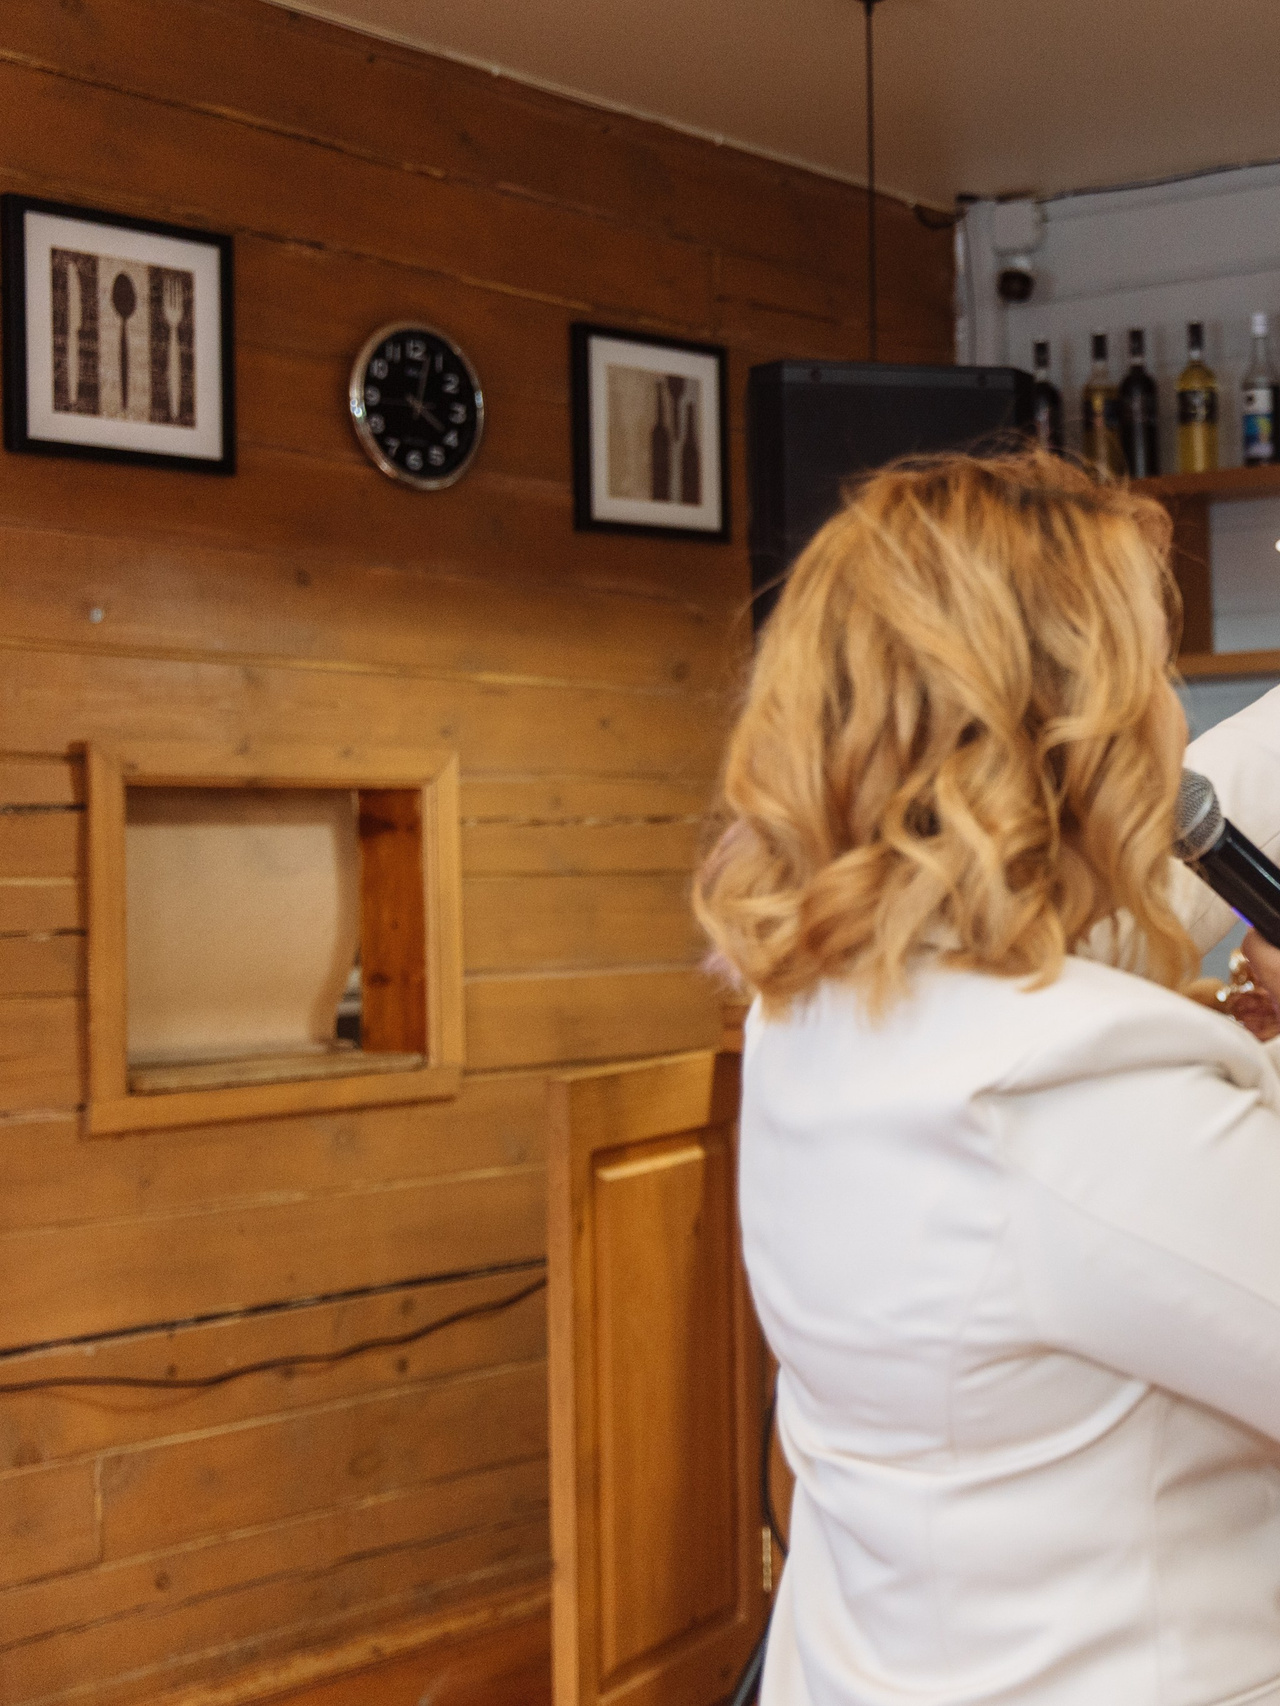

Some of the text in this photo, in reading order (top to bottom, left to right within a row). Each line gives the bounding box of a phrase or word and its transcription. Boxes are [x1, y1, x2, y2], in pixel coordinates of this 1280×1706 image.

[405, 339, 427, 361] 12
[370, 358, 389, 380] 10
[435, 352, 443, 373] 1
[442, 373, 460, 394] 2
[448, 402, 467, 424] 3
[384, 436, 401, 457] 7
[443, 429, 459, 449] 4
[405, 449, 424, 471] 6
